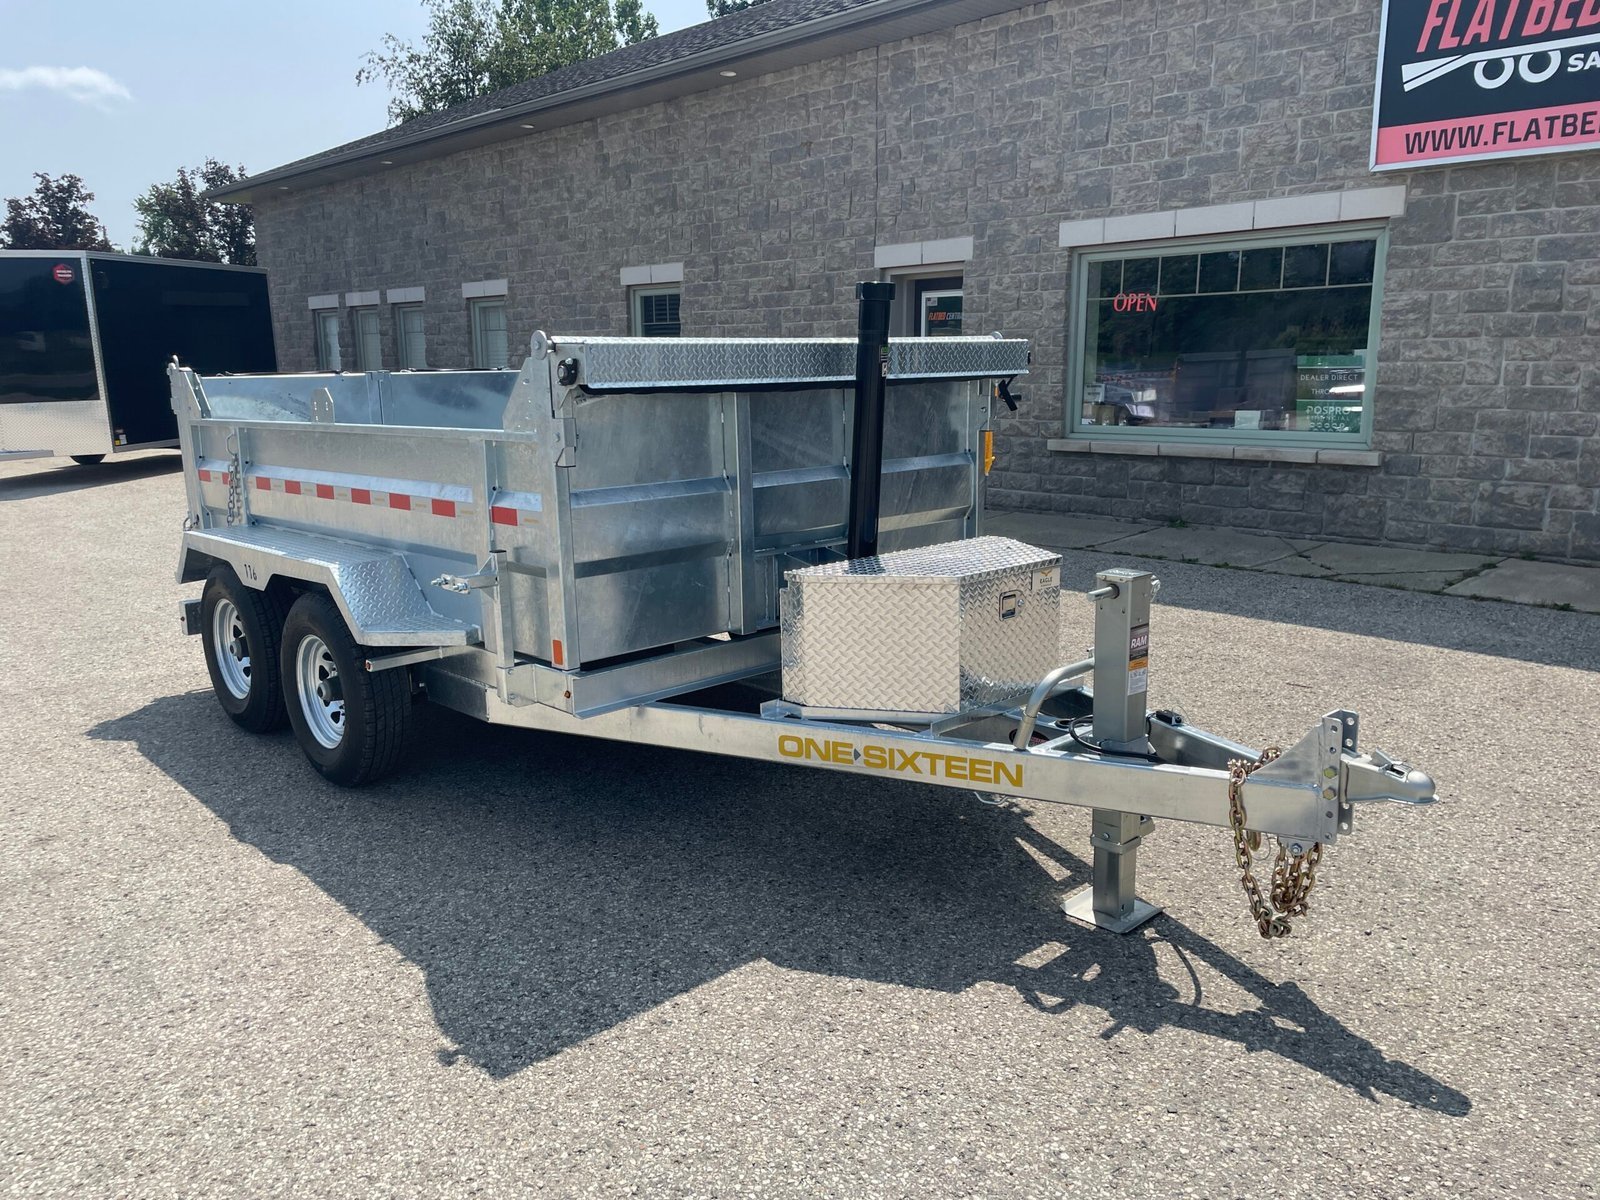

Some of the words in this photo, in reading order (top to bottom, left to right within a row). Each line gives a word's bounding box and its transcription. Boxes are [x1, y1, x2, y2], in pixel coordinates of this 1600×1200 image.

[1405, 111, 1600, 155] WWW.FLATBE
[1112, 293, 1158, 312] OPEN
[244, 563, 258, 581] 116
[1130, 635, 1148, 649] RAM
[778, 735, 854, 765] ONE
[863, 745, 1023, 788] SIXTEEN
